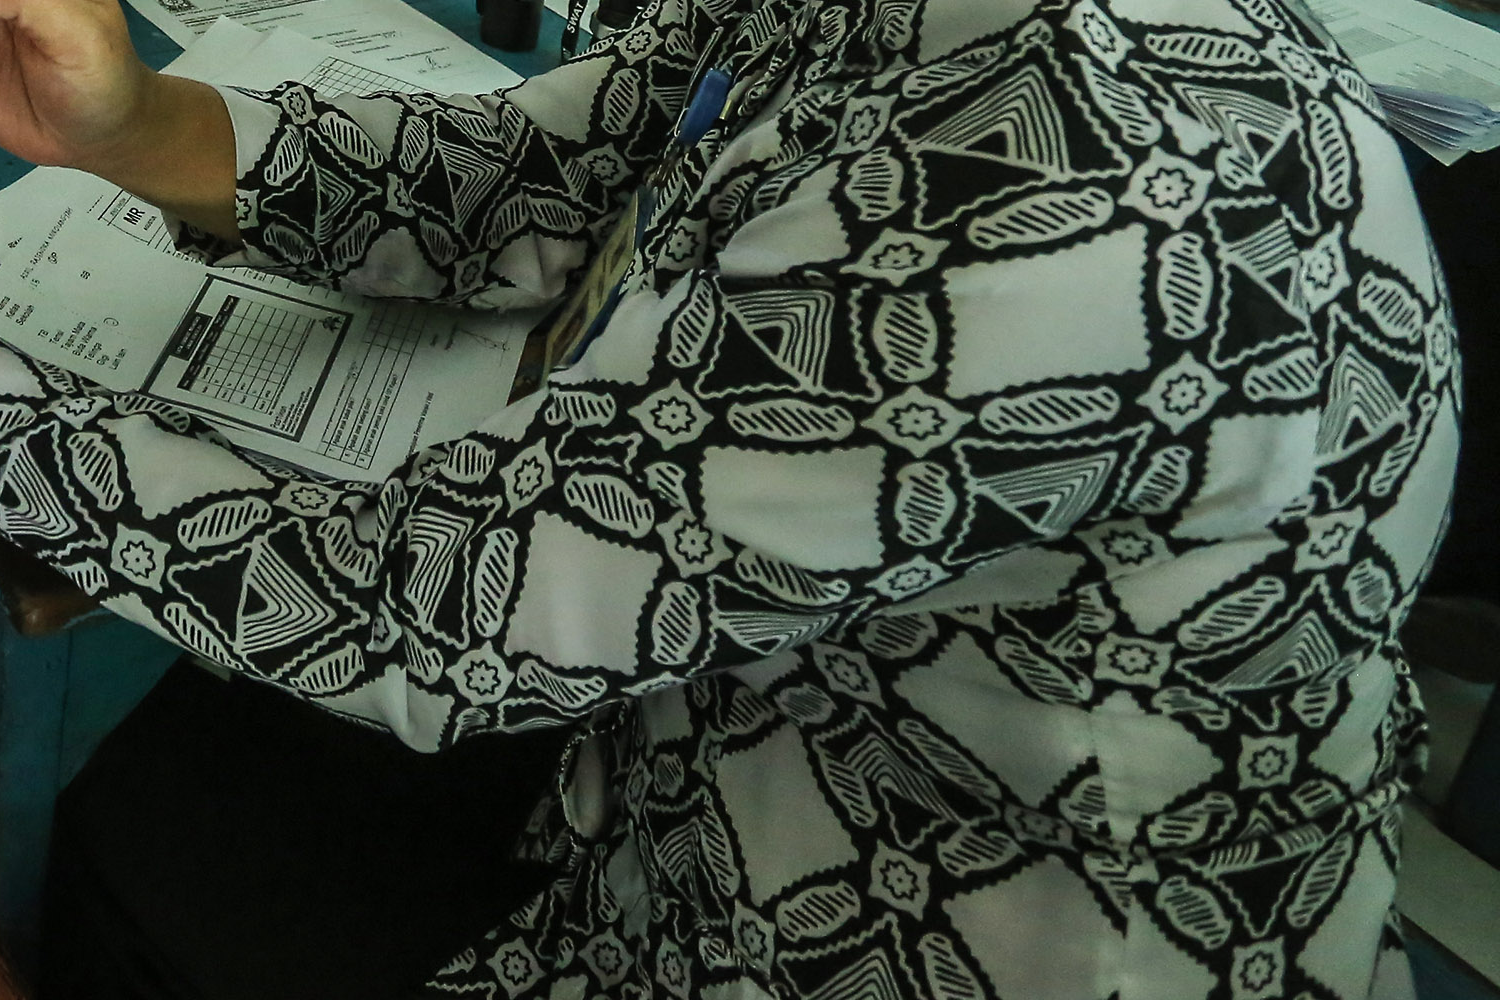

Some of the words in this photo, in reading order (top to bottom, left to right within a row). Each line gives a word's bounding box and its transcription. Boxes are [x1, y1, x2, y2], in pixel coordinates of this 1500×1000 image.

[567, 2, 583, 33] SWAT
[123, 207, 145, 225] MR
[5, 303, 20, 319] Kelas
[16, 304, 34, 326] Sekolah
[37, 328, 48, 338] TB
[72, 342, 85, 356] Buta
[84, 342, 102, 360] Telinga
